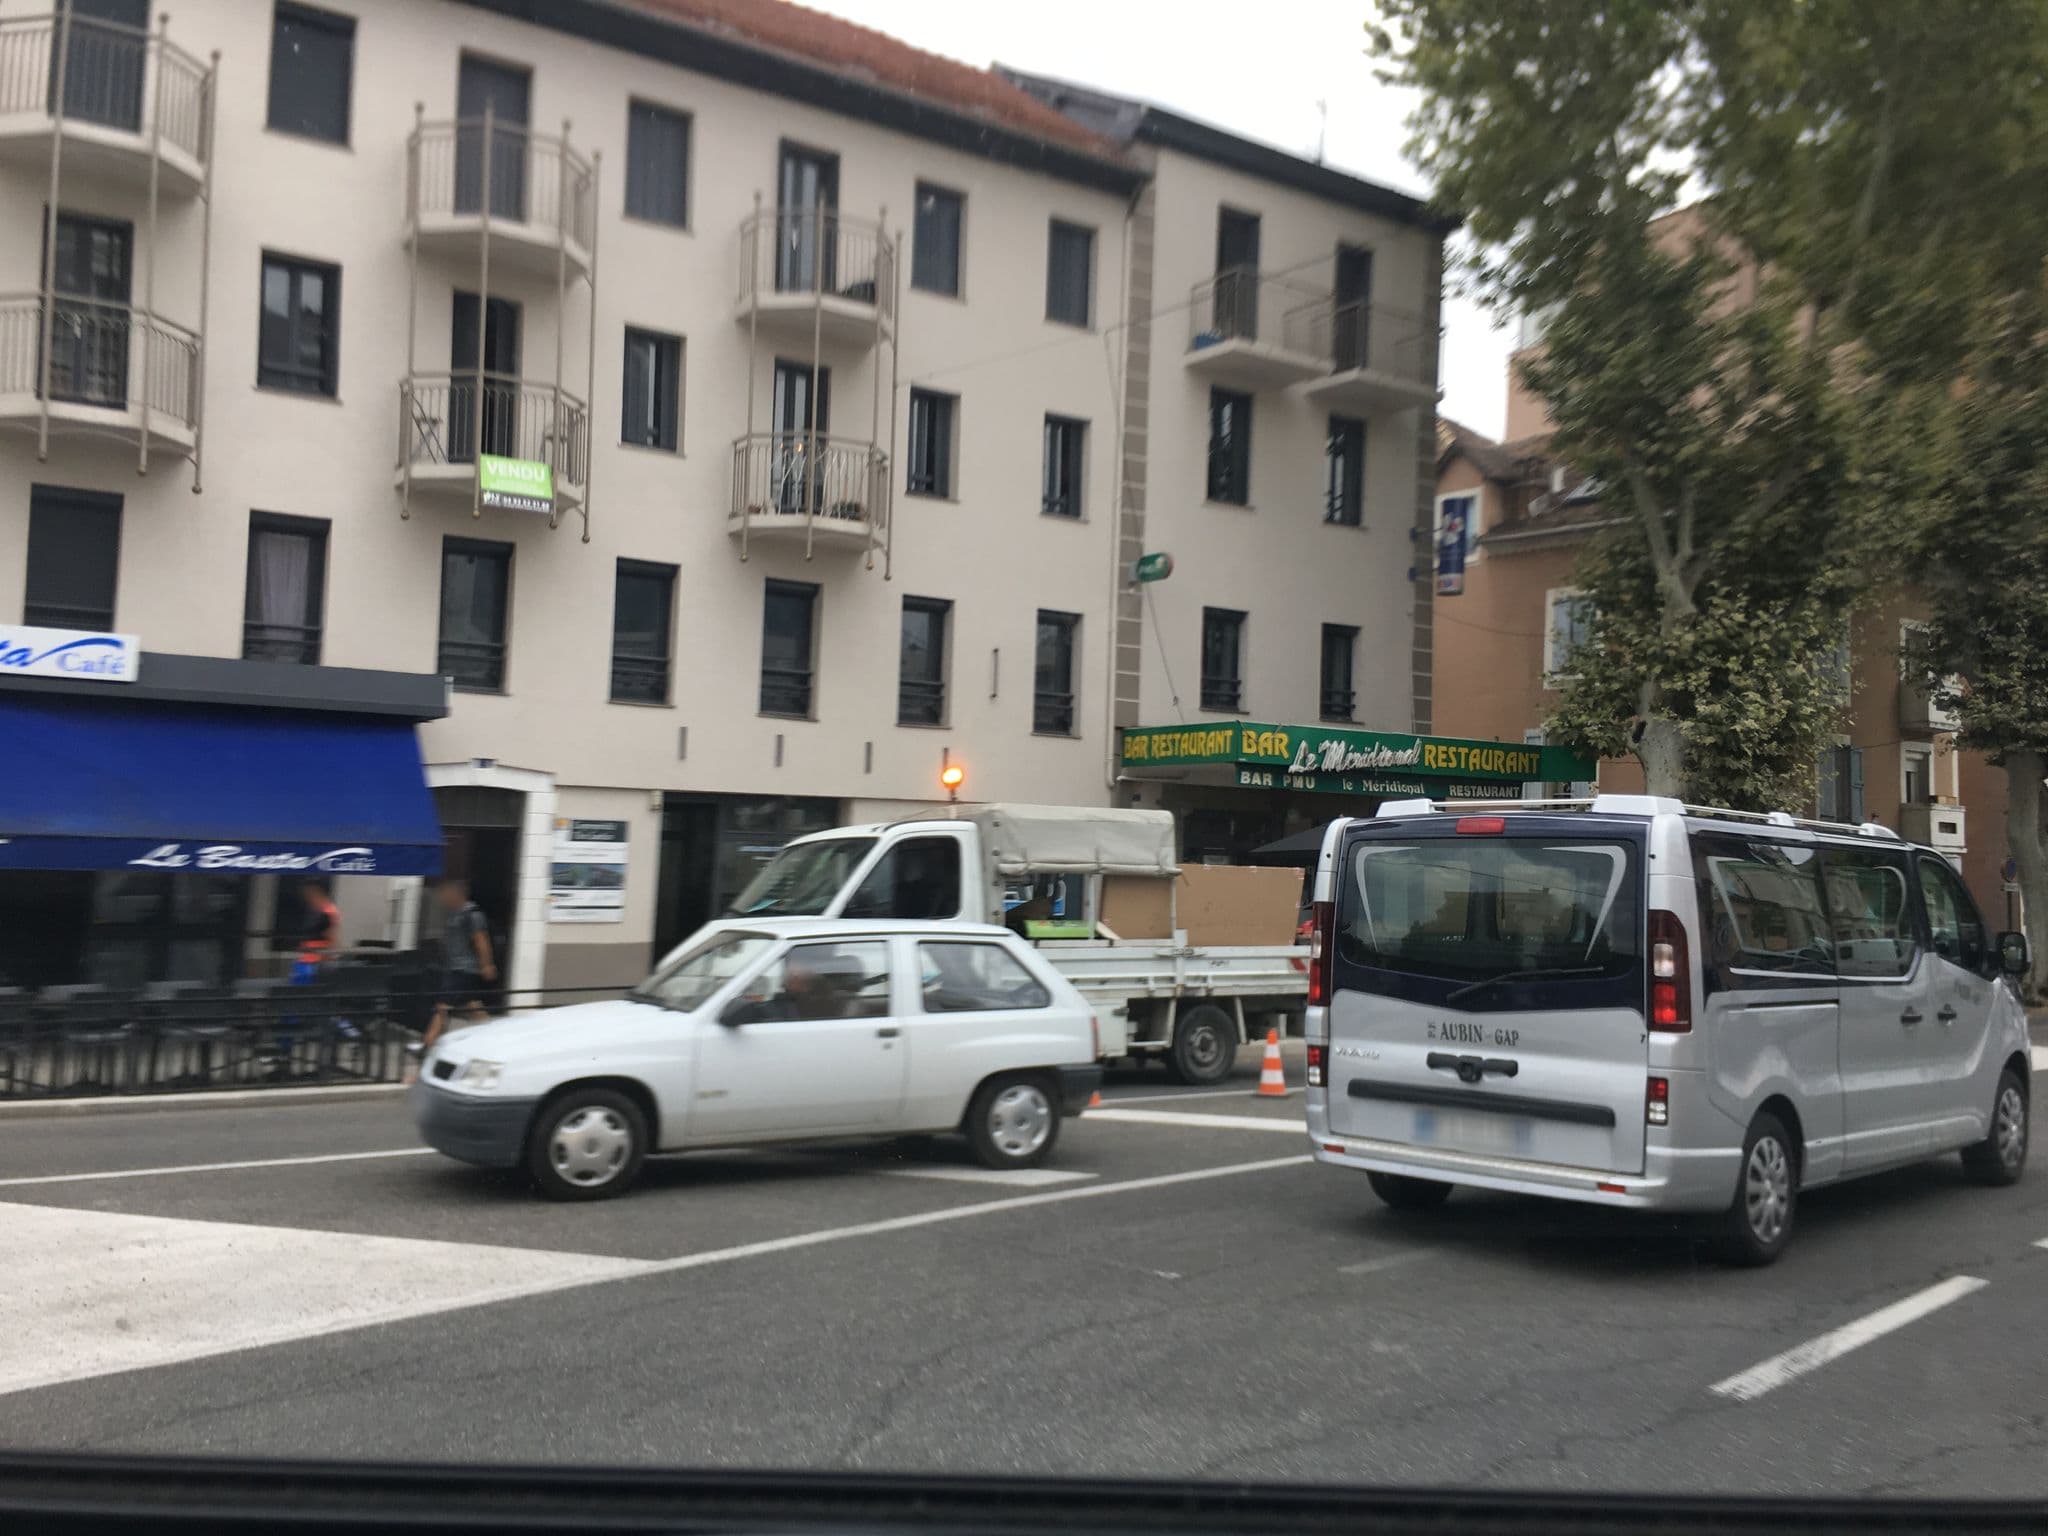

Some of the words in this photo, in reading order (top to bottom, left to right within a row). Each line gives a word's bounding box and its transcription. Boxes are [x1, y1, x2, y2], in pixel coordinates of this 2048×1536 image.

[486, 460, 545, 482] VENDU
[56, 652, 125, 674] Café
[1124, 735, 1149, 759] BAR
[1151, 730, 1233, 759] RESTAURANT
[1242, 731, 1289, 758] BAR
[1288, 740, 1318, 773] Le
[1424, 744, 1540, 775] RESTAURANT
[1240, 771, 1272, 785] BAR
[1283, 776, 1315, 789] PMU
[1342, 779, 1353, 790] le
[1449, 784, 1519, 798] RESTAURANT
[1440, 1022, 1483, 1043] AUBIN
[1494, 1028, 1520, 1046] GAP
